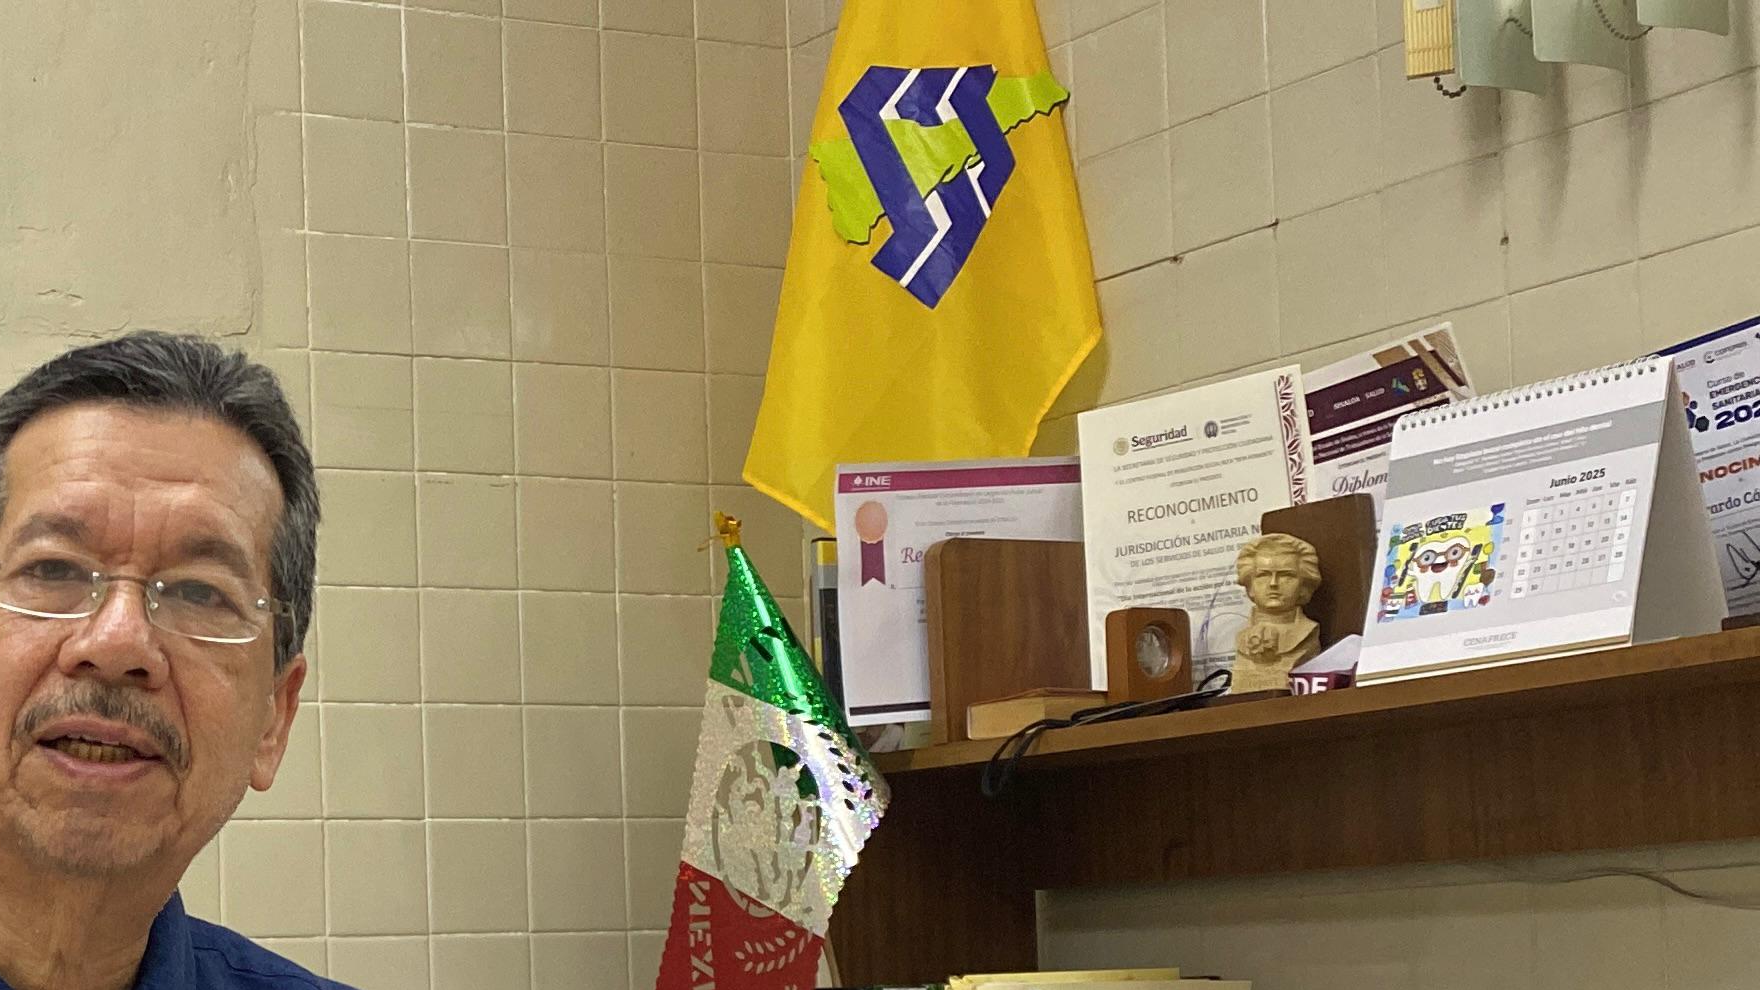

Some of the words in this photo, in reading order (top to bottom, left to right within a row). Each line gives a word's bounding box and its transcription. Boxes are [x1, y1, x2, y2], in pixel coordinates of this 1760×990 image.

[1707, 376, 1732, 388] Curso
[1131, 425, 1188, 448] Seguridad
[864, 475, 891, 487] INE
[1549, 474, 1577, 489] Junio
[1579, 467, 1606, 483] 2025
[1127, 487, 1258, 525] RECONOCIMIENTO
[1114, 535, 1191, 558] JURISDICCIÓN
[1193, 526, 1249, 547] SANITARIA
